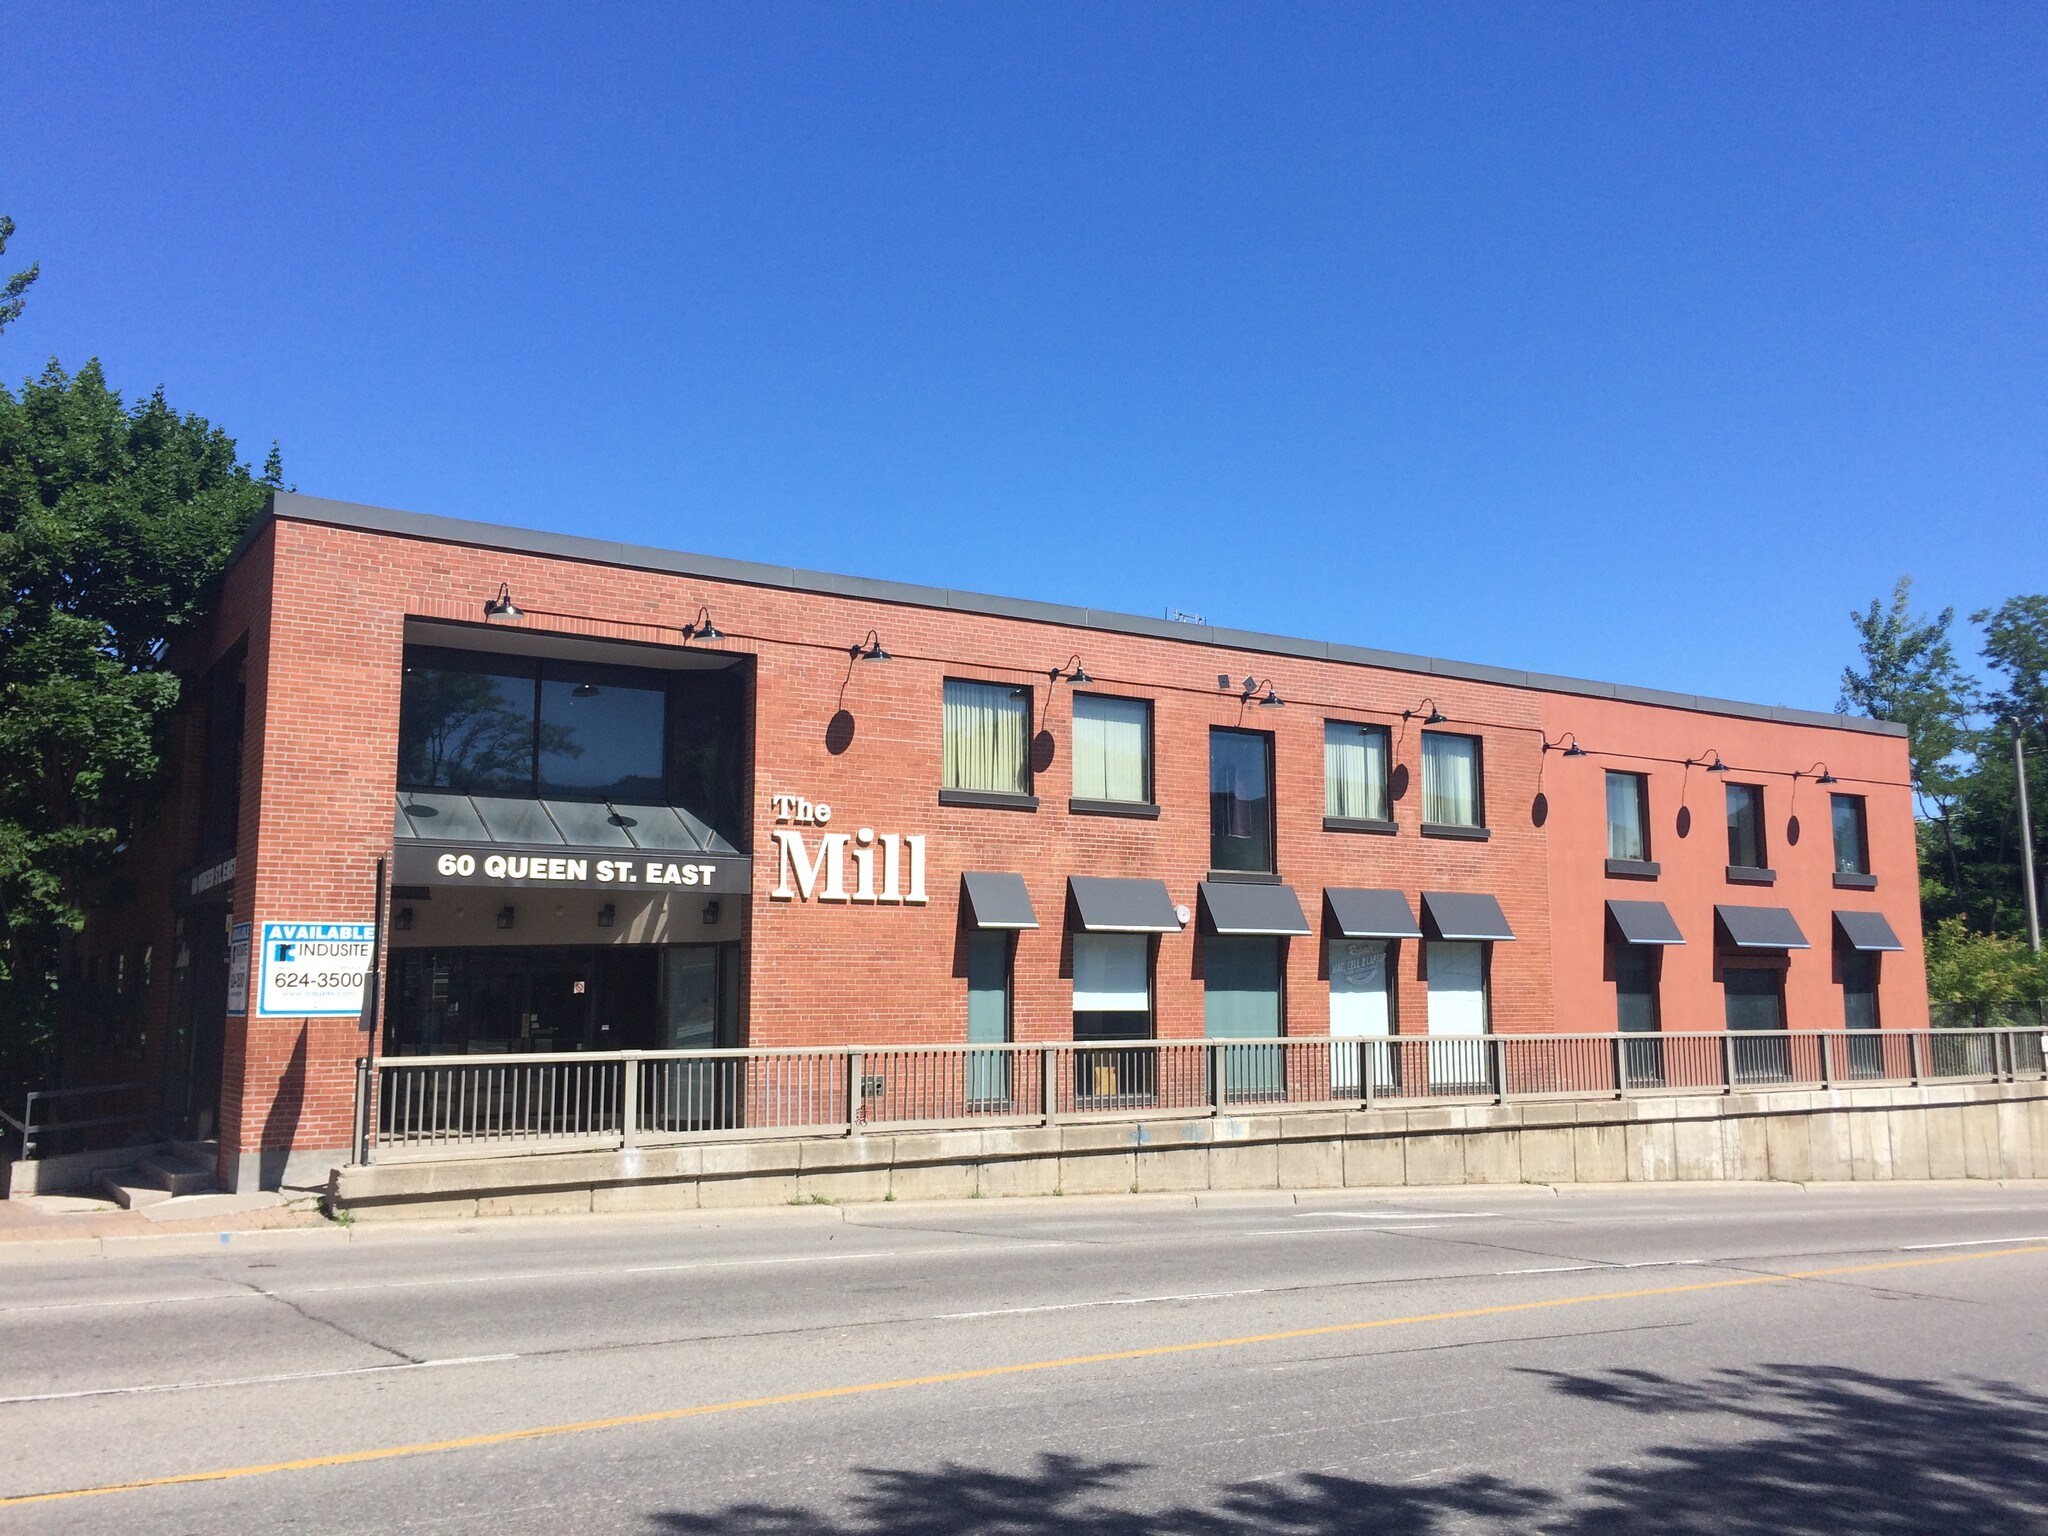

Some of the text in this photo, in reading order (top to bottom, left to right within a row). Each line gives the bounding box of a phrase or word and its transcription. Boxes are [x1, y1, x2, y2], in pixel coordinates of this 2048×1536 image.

[773, 794, 831, 826] The
[438, 854, 716, 886] 60 QUEEN ST. EAST
[770, 828, 929, 906] Mill
[268, 925, 375, 940] AVAILABLE
[299, 944, 368, 957] INDUSITE
[1348, 959, 1360, 970] CELL
[1361, 957, 1366, 967] &
[1366, 953, 1386, 965] LAPTOP
[275, 972, 363, 988] 624-3500
